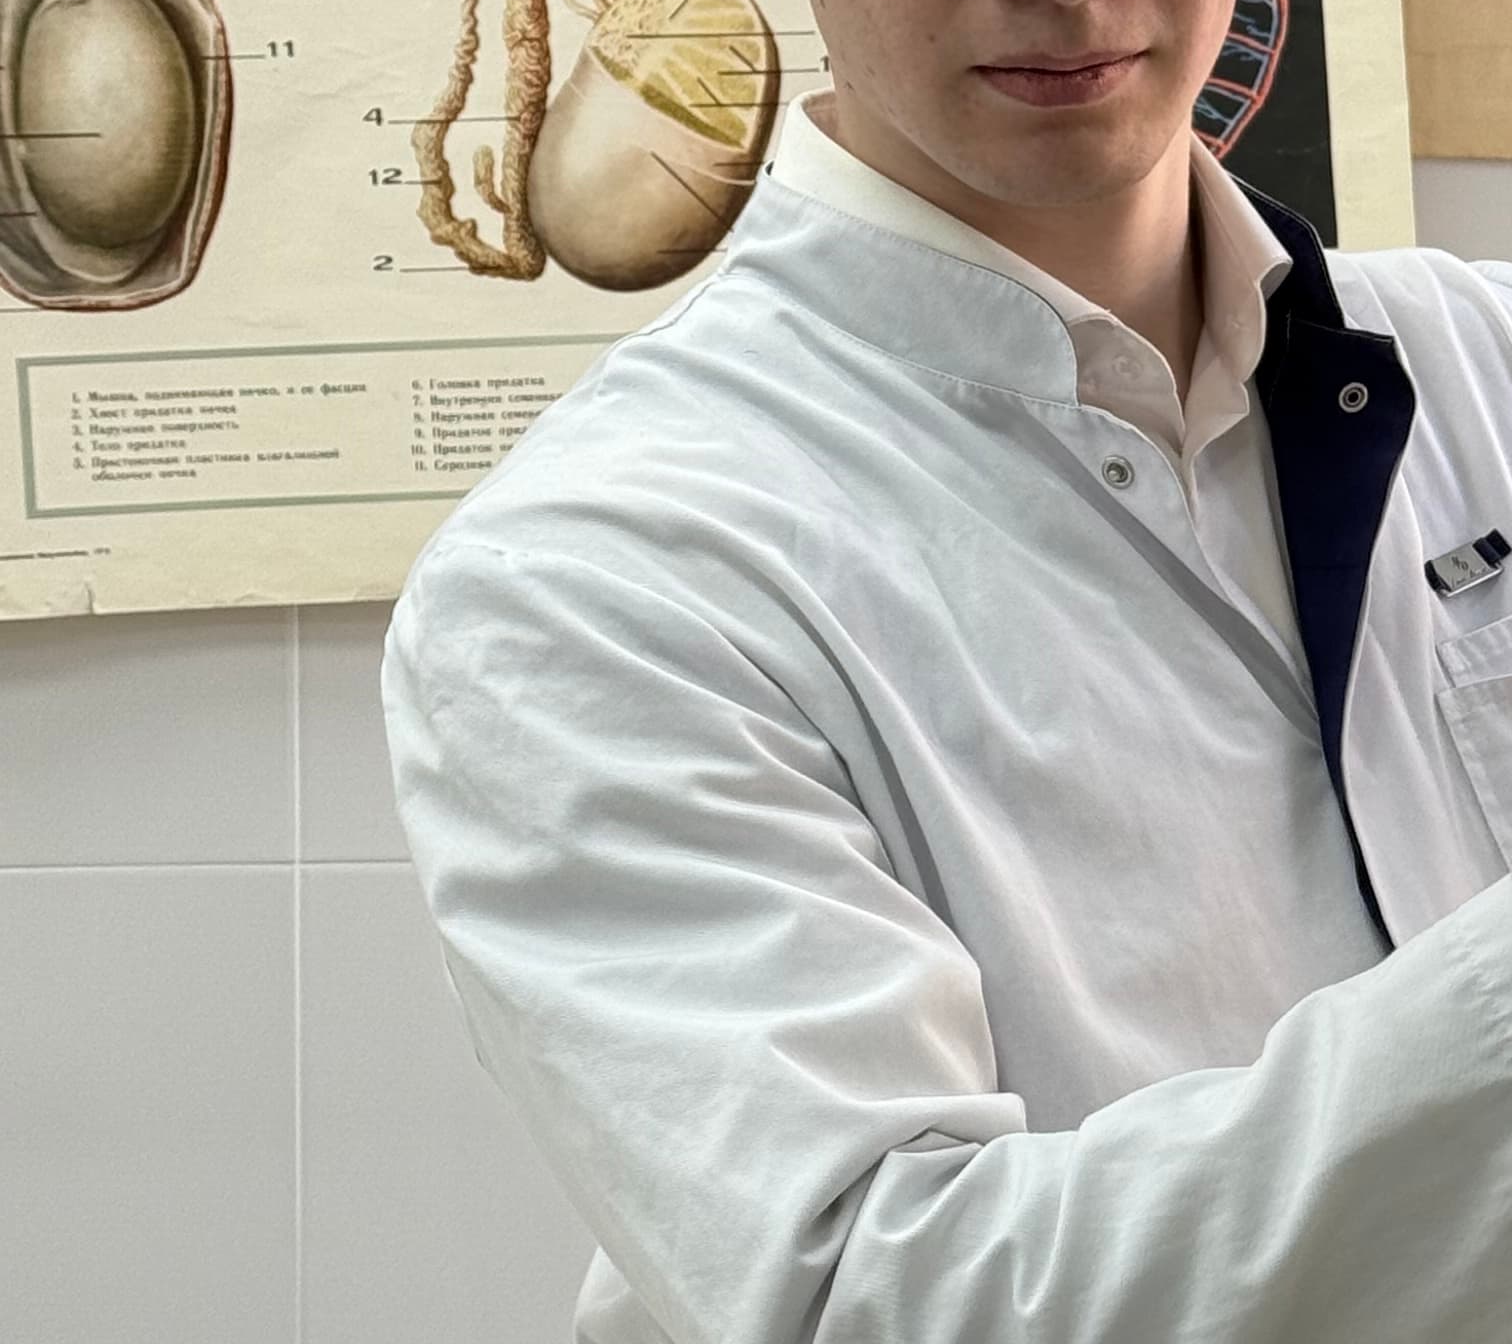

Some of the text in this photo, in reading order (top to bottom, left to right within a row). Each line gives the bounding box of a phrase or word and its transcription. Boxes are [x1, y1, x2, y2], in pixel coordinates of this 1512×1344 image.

[266, 39, 296, 58] 11
[362, 107, 384, 127] 4
[367, 166, 403, 187] 12
[373, 254, 394, 272] 2
